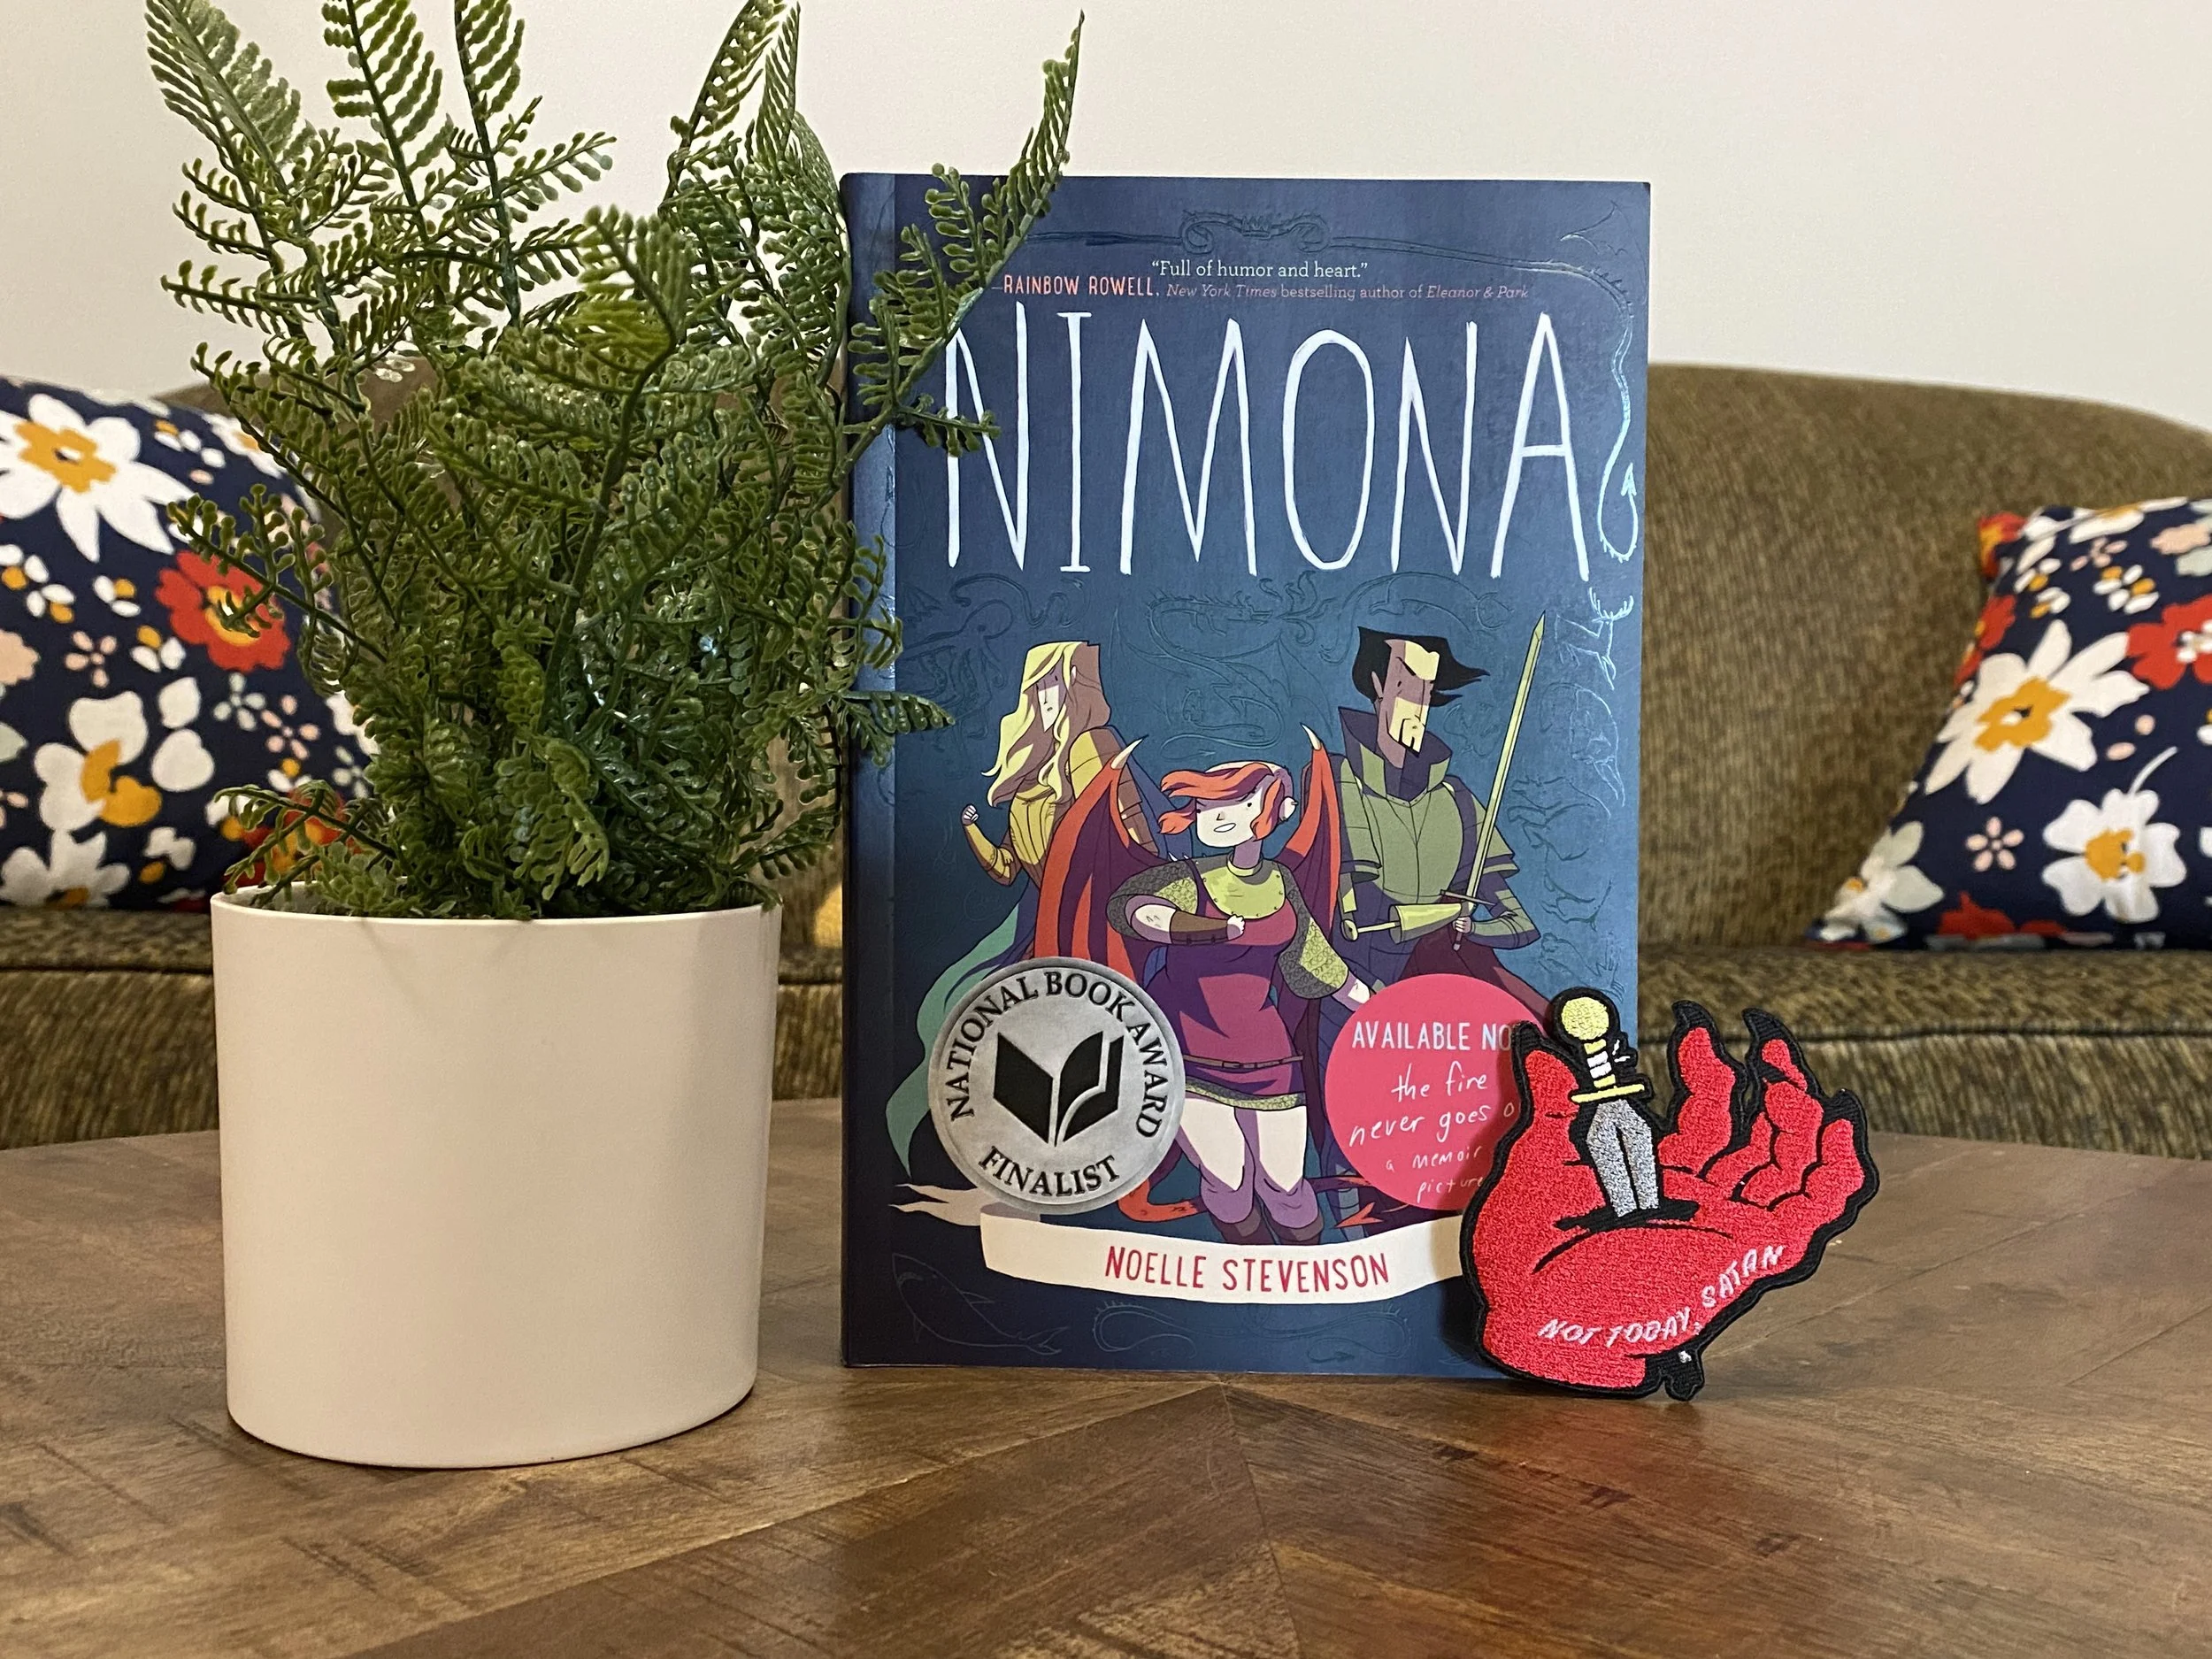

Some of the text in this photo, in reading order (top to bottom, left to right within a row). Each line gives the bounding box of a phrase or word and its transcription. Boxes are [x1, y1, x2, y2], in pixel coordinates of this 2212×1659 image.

[1196, 259, 1213, 277] of
[1217, 260, 1273, 277] humor
[1279, 260, 1309, 277] and
[1166, 283, 1196, 297] New
[1202, 283, 1230, 297] York
[1236, 283, 1277, 298] Times
[1281, 283, 1355, 302] bestselling
[1360, 284, 1405, 298] author
[1409, 283, 1424, 299] of
[1426, 285, 1480, 299] Eleanor
[1483, 285, 1494, 298] &
[1496, 285, 1529, 299] Park
[946, 302, 1589, 582] NIMONA
[946, 971, 1169, 1138] NATIONAL BOOK AWARD
[1351, 1020, 1512, 1051] AVAILABLE NO
[1390, 1060, 1488, 1102] the fire
[1349, 1115, 1425, 1148] never
[1436, 1104, 1493, 1143] goes
[978, 1145, 1121, 1197] FINALIST
[1386, 1146, 1483, 1172] a memoir
[1417, 1176, 1483, 1204] picture
[1105, 1245, 1390, 1294] NOELLE STEVENSON
[1537, 1318, 1601, 1346] NOT
[1701, 1244, 1786, 1309] SATAN
